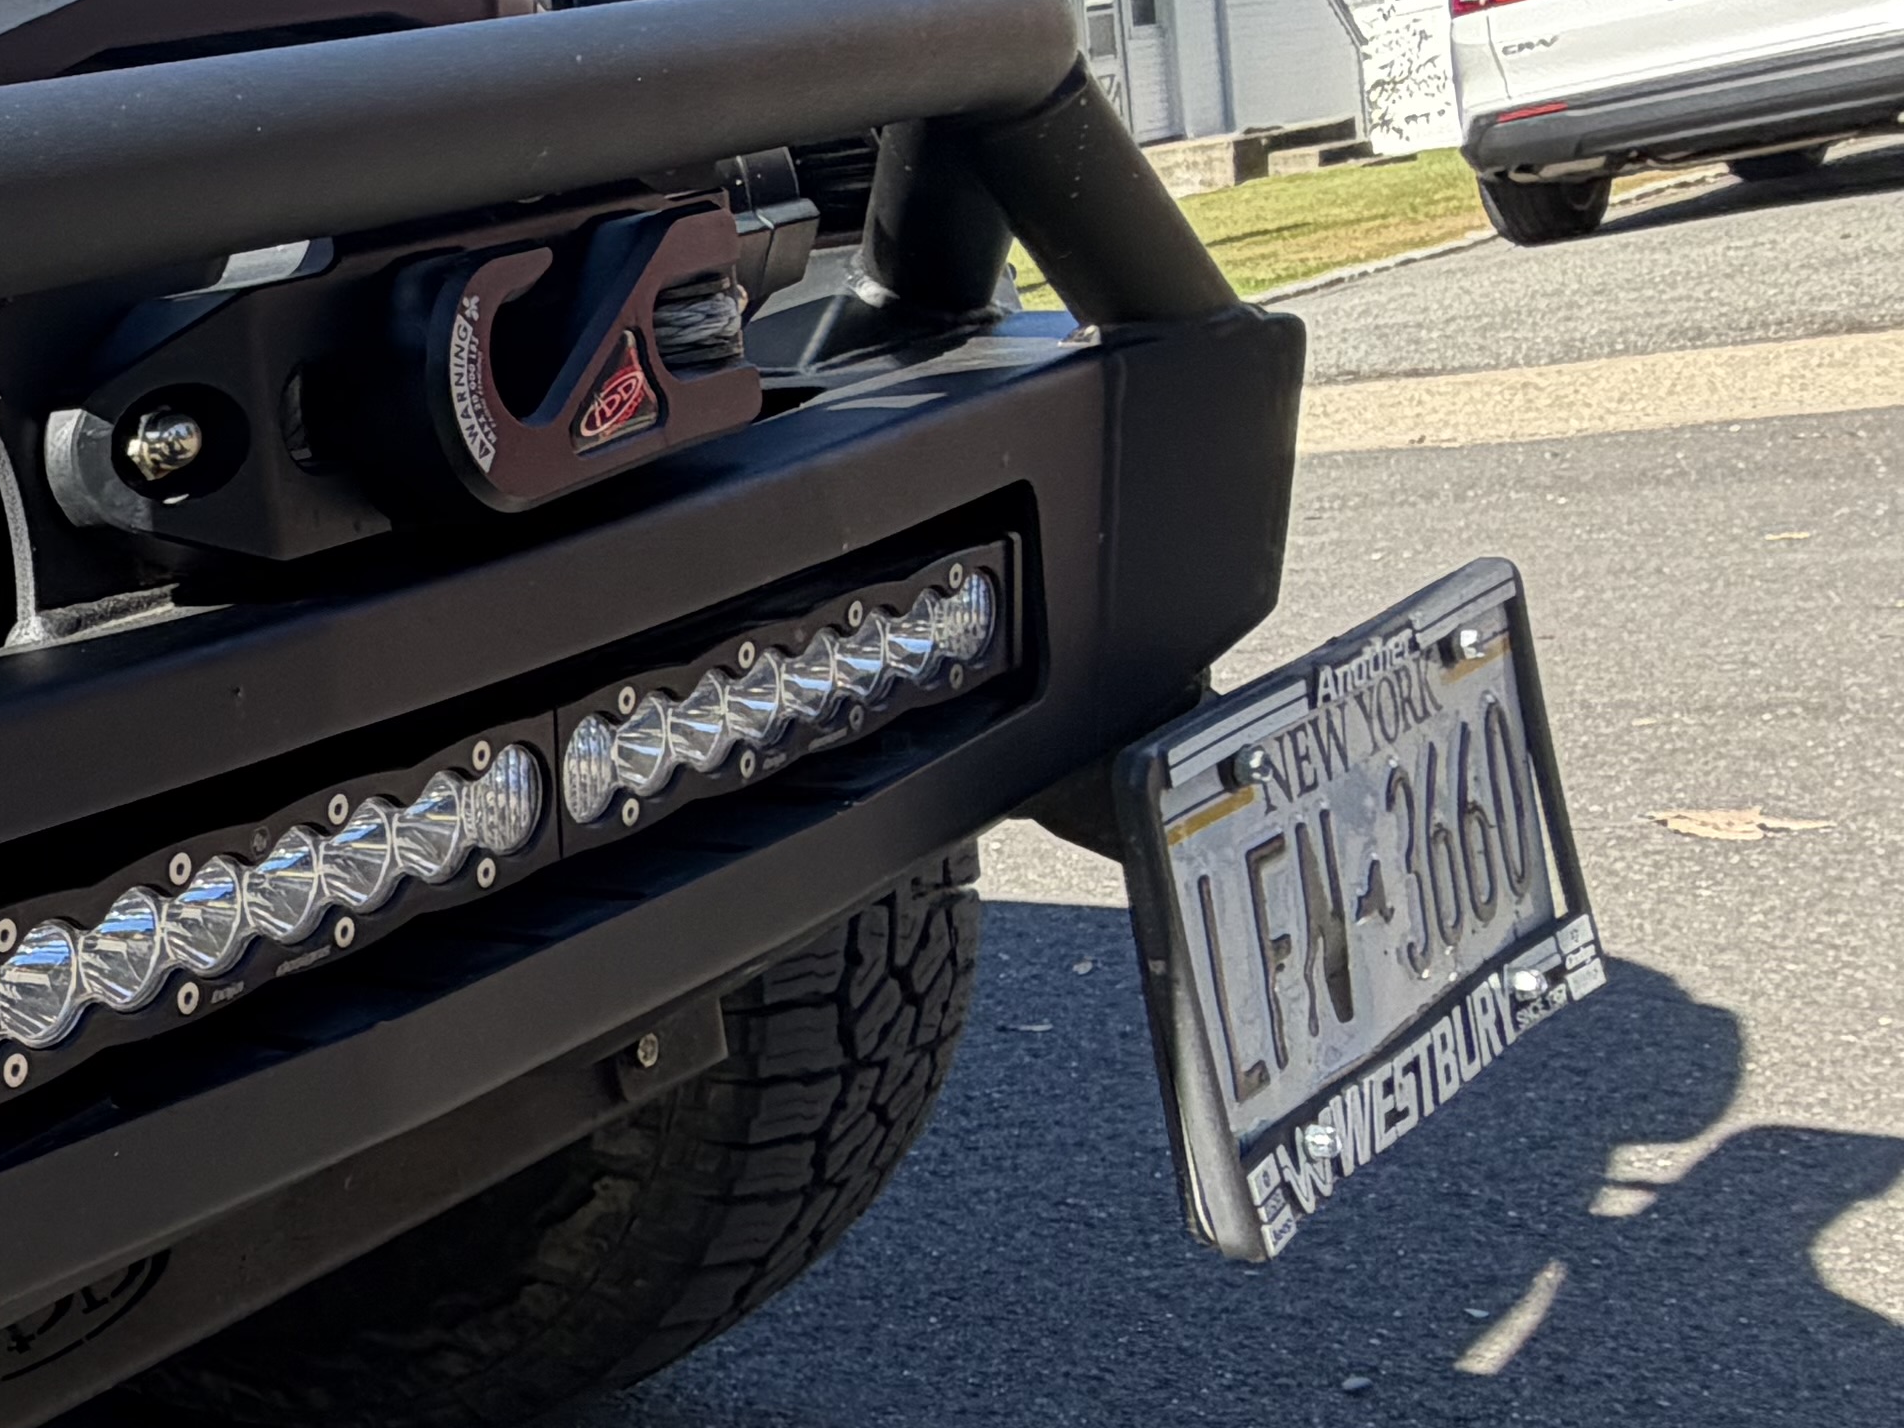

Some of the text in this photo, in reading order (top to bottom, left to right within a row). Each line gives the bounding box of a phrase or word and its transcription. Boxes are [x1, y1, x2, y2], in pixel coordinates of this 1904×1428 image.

[453, 324, 480, 446] WARNING
[1260, 651, 1443, 817] NEW YORK
[1317, 627, 1418, 709] Another
[1197, 698, 1532, 1104] LFN 3660
[1329, 963, 1520, 1177] WESTBURY
